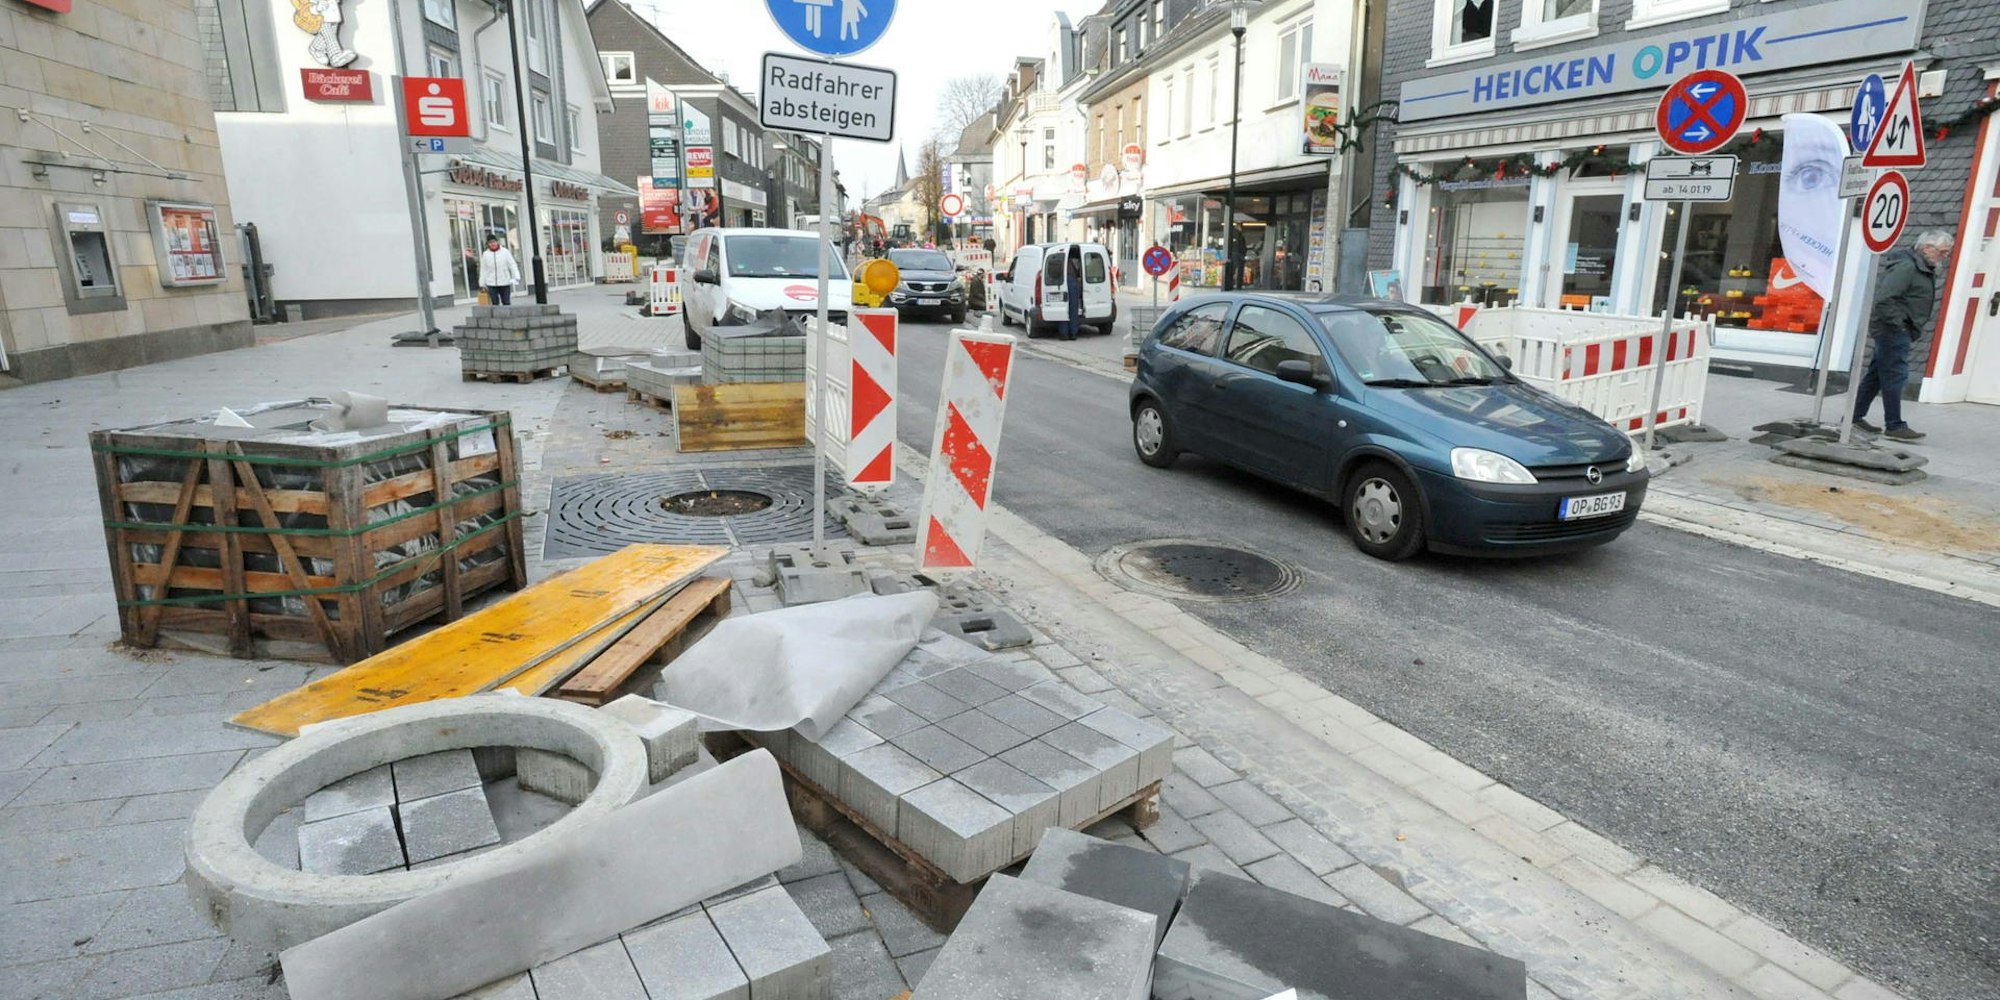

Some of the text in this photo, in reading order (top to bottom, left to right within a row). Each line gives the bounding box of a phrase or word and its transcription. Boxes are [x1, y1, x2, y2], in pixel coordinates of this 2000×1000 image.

[1472, 25, 1768, 103] HEICKEN OPTIK
[770, 65, 884, 100] Radfahrer
[1308, 67, 1339, 82] Mama
[769, 96, 876, 130] absteigen
[432, 139, 443, 150] P
[687, 151, 713, 162] REWE
[1662, 184, 1713, 195] ab 14.01.19
[1122, 200, 1141, 212] sky
[1871, 193, 1901, 229] 20
[1571, 494, 1622, 516] OP BG 93
